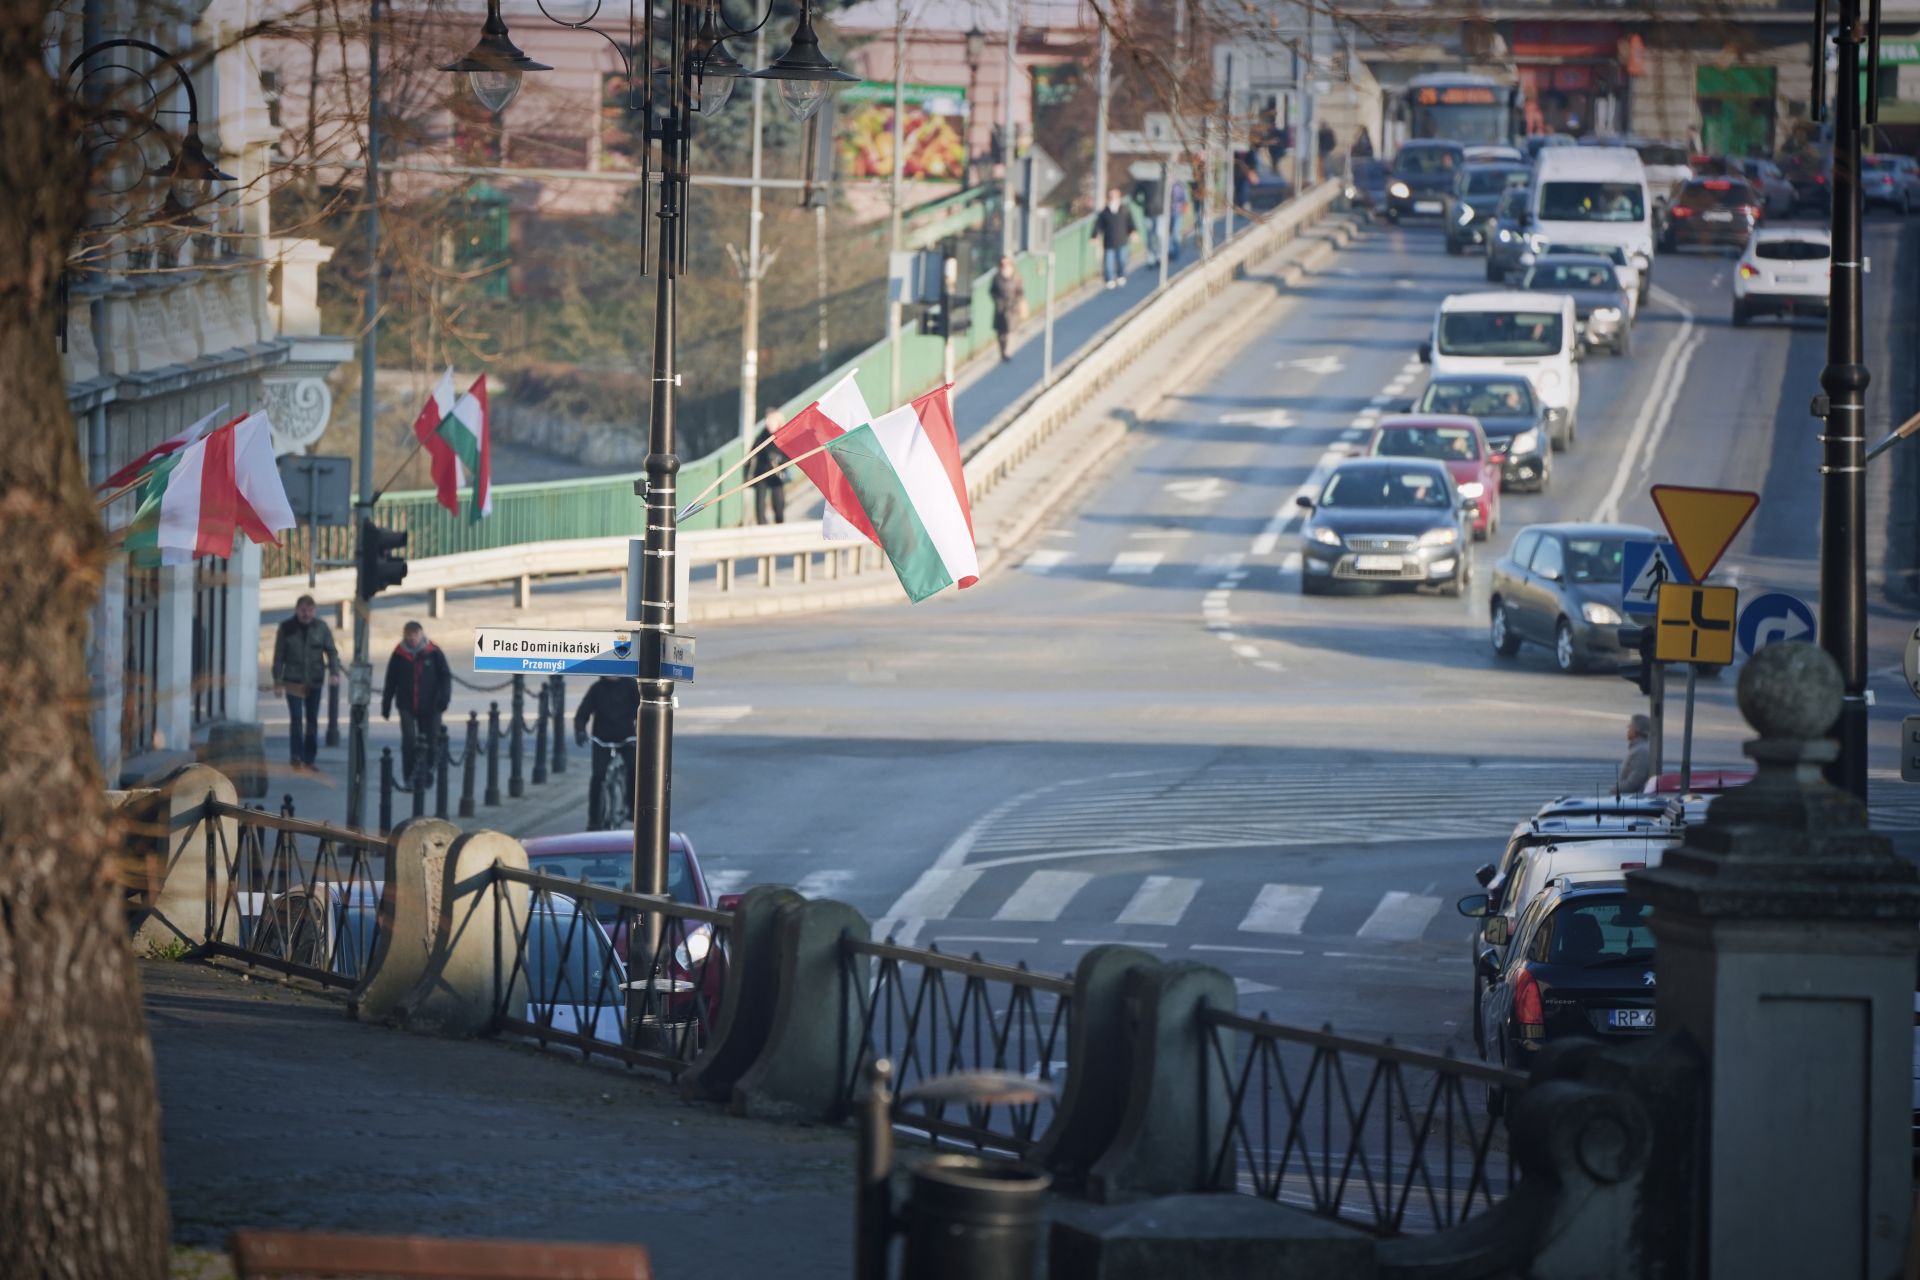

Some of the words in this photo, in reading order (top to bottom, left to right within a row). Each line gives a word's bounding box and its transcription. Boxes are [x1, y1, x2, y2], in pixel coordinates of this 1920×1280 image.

[493, 639, 519, 652] Plac
[521, 640, 600, 654] Dominikański
[522, 659, 566, 671] Przemyśl
[1618, 1010, 1640, 1026] RP
